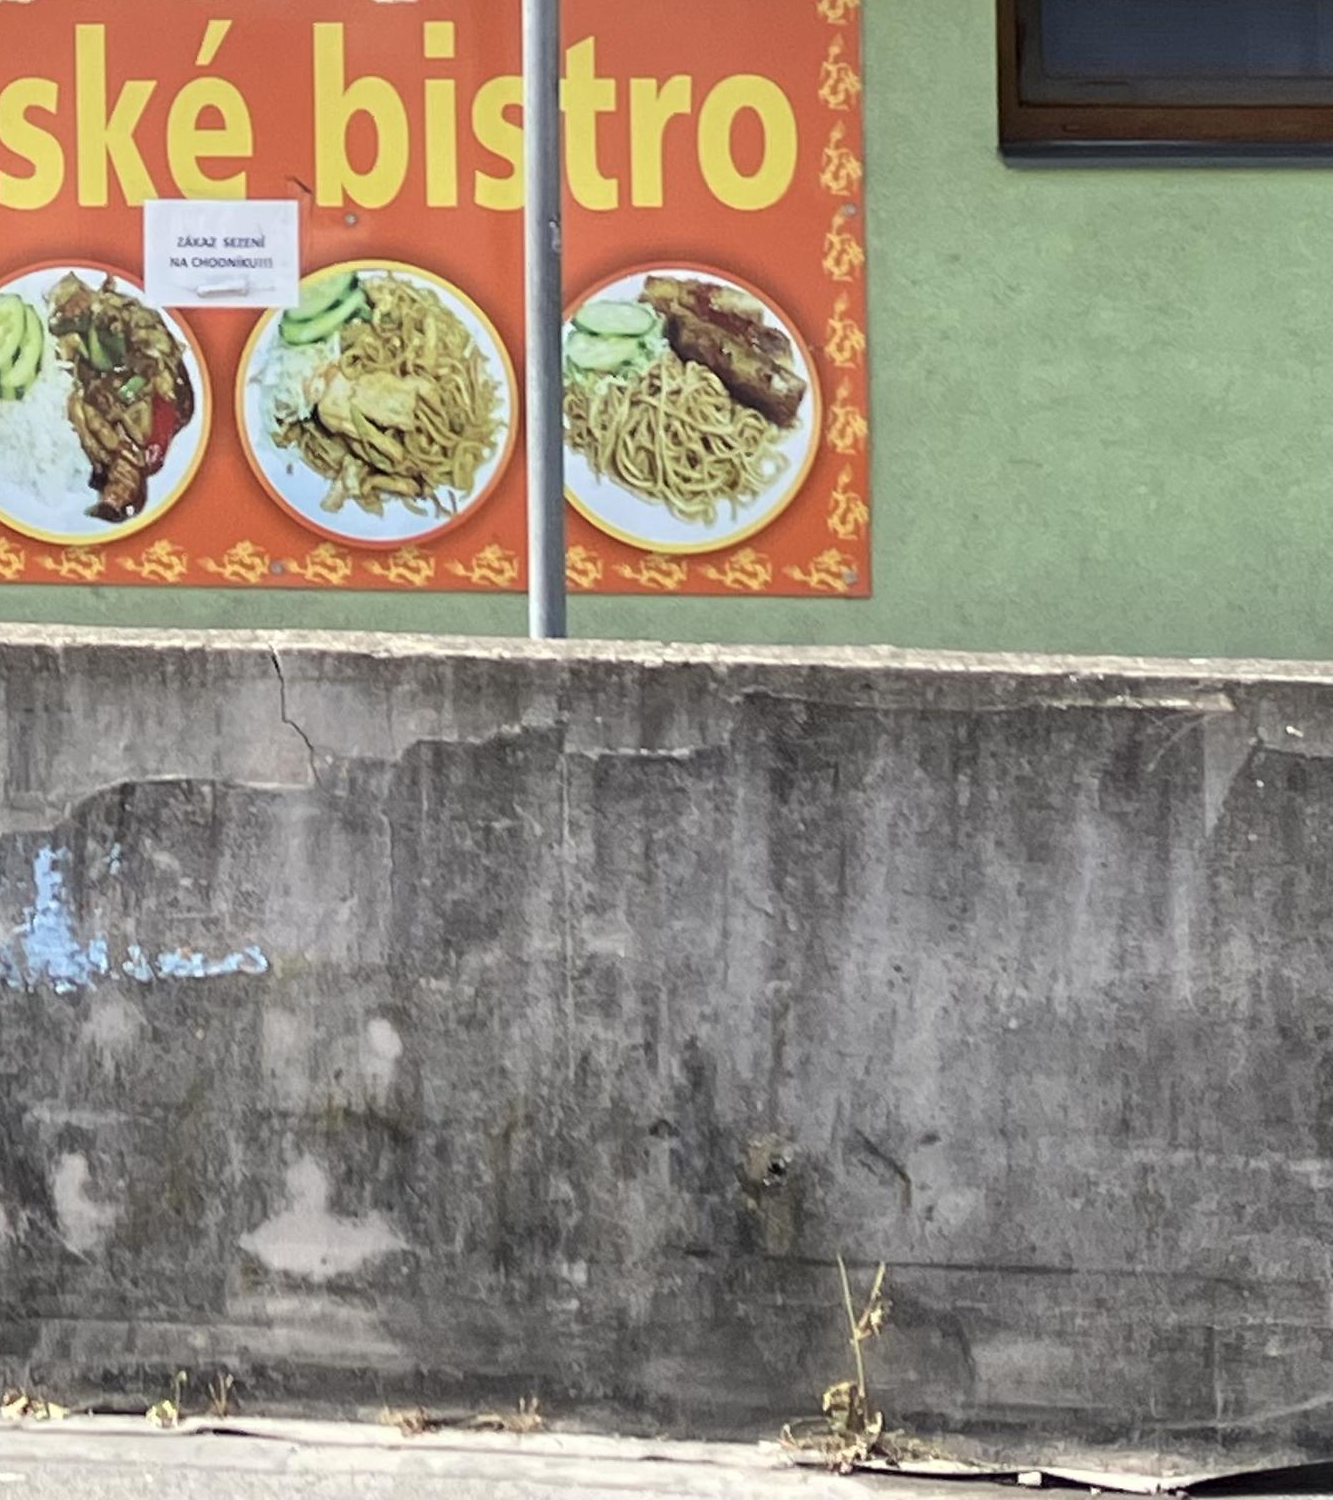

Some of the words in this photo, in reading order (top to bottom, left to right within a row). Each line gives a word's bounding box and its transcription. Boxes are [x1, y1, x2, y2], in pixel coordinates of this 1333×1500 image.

[313, 21, 798, 211] bistro
[177, 235, 216, 248] ZÁKAZ
[223, 234, 266, 248] SEZENÍ
[170, 257, 188, 268] NA
